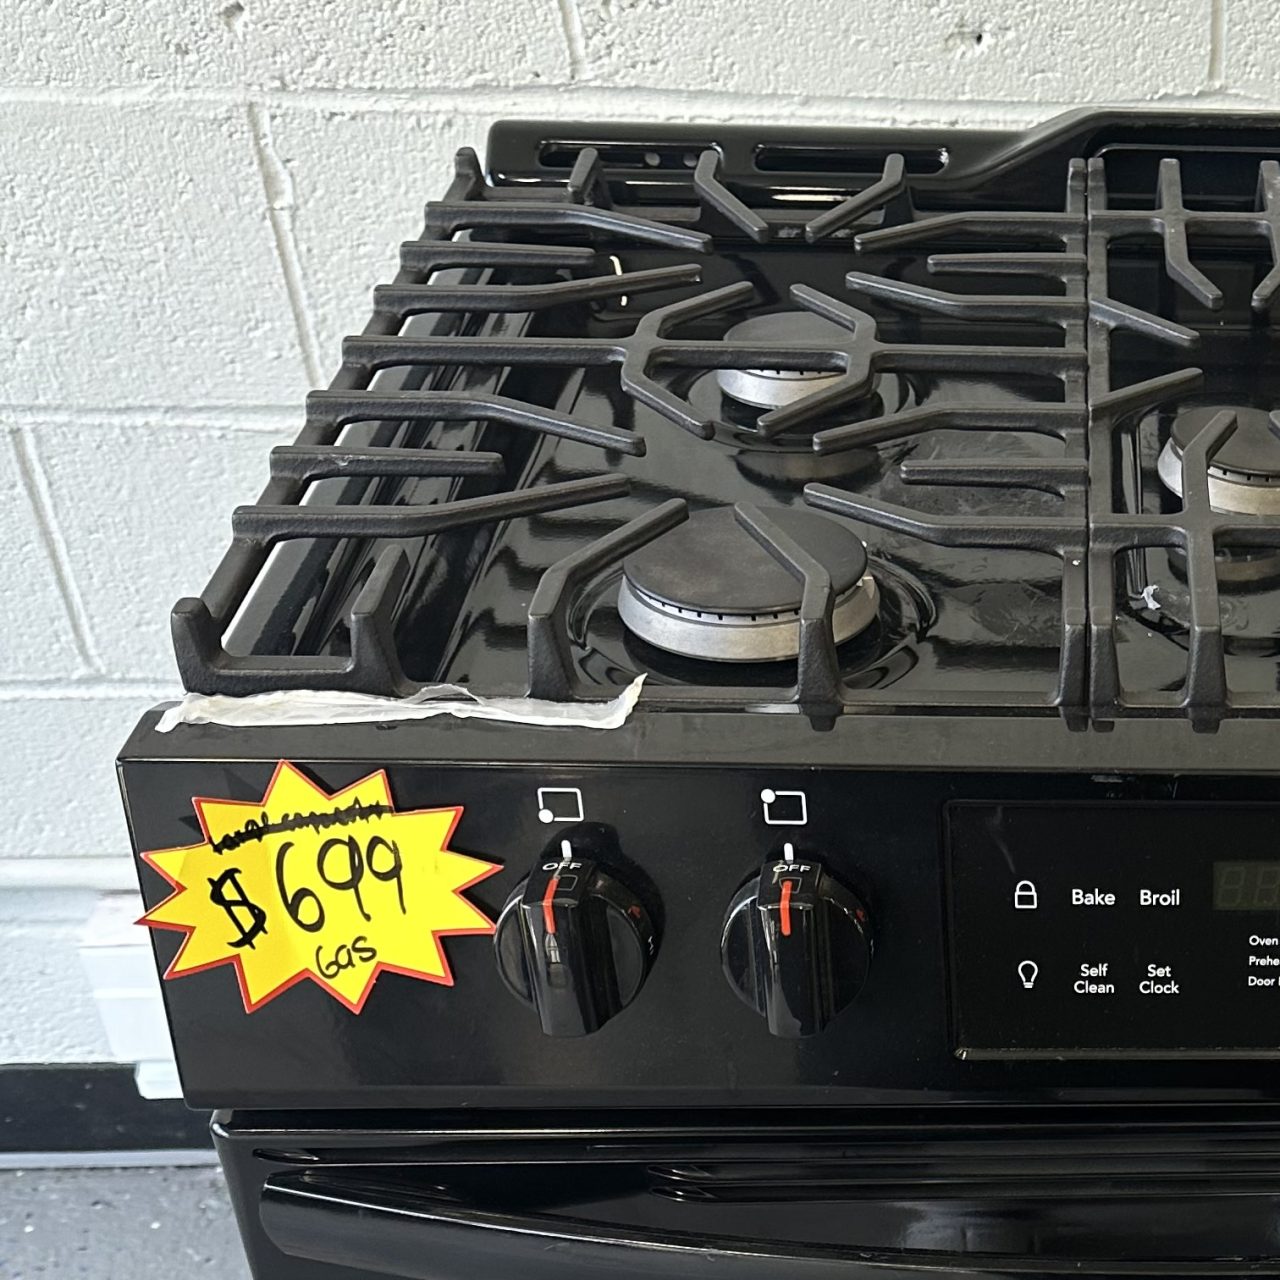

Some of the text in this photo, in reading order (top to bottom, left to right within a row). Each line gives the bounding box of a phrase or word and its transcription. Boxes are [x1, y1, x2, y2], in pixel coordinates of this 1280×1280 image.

[542, 861, 582, 871] OFF
[772, 864, 811, 873] OFF
[207, 834, 406, 950] $699
[1071, 887, 1116, 906] Bake
[1139, 888, 1180, 906] Broil
[1248, 934, 1279, 946] Oven
[1080, 962, 1109, 977] Self
[1147, 963, 1172, 978] Set
[1073, 979, 1115, 994] Clean
[1138, 980, 1180, 994] Clock
[1247, 975, 1275, 987] Door
